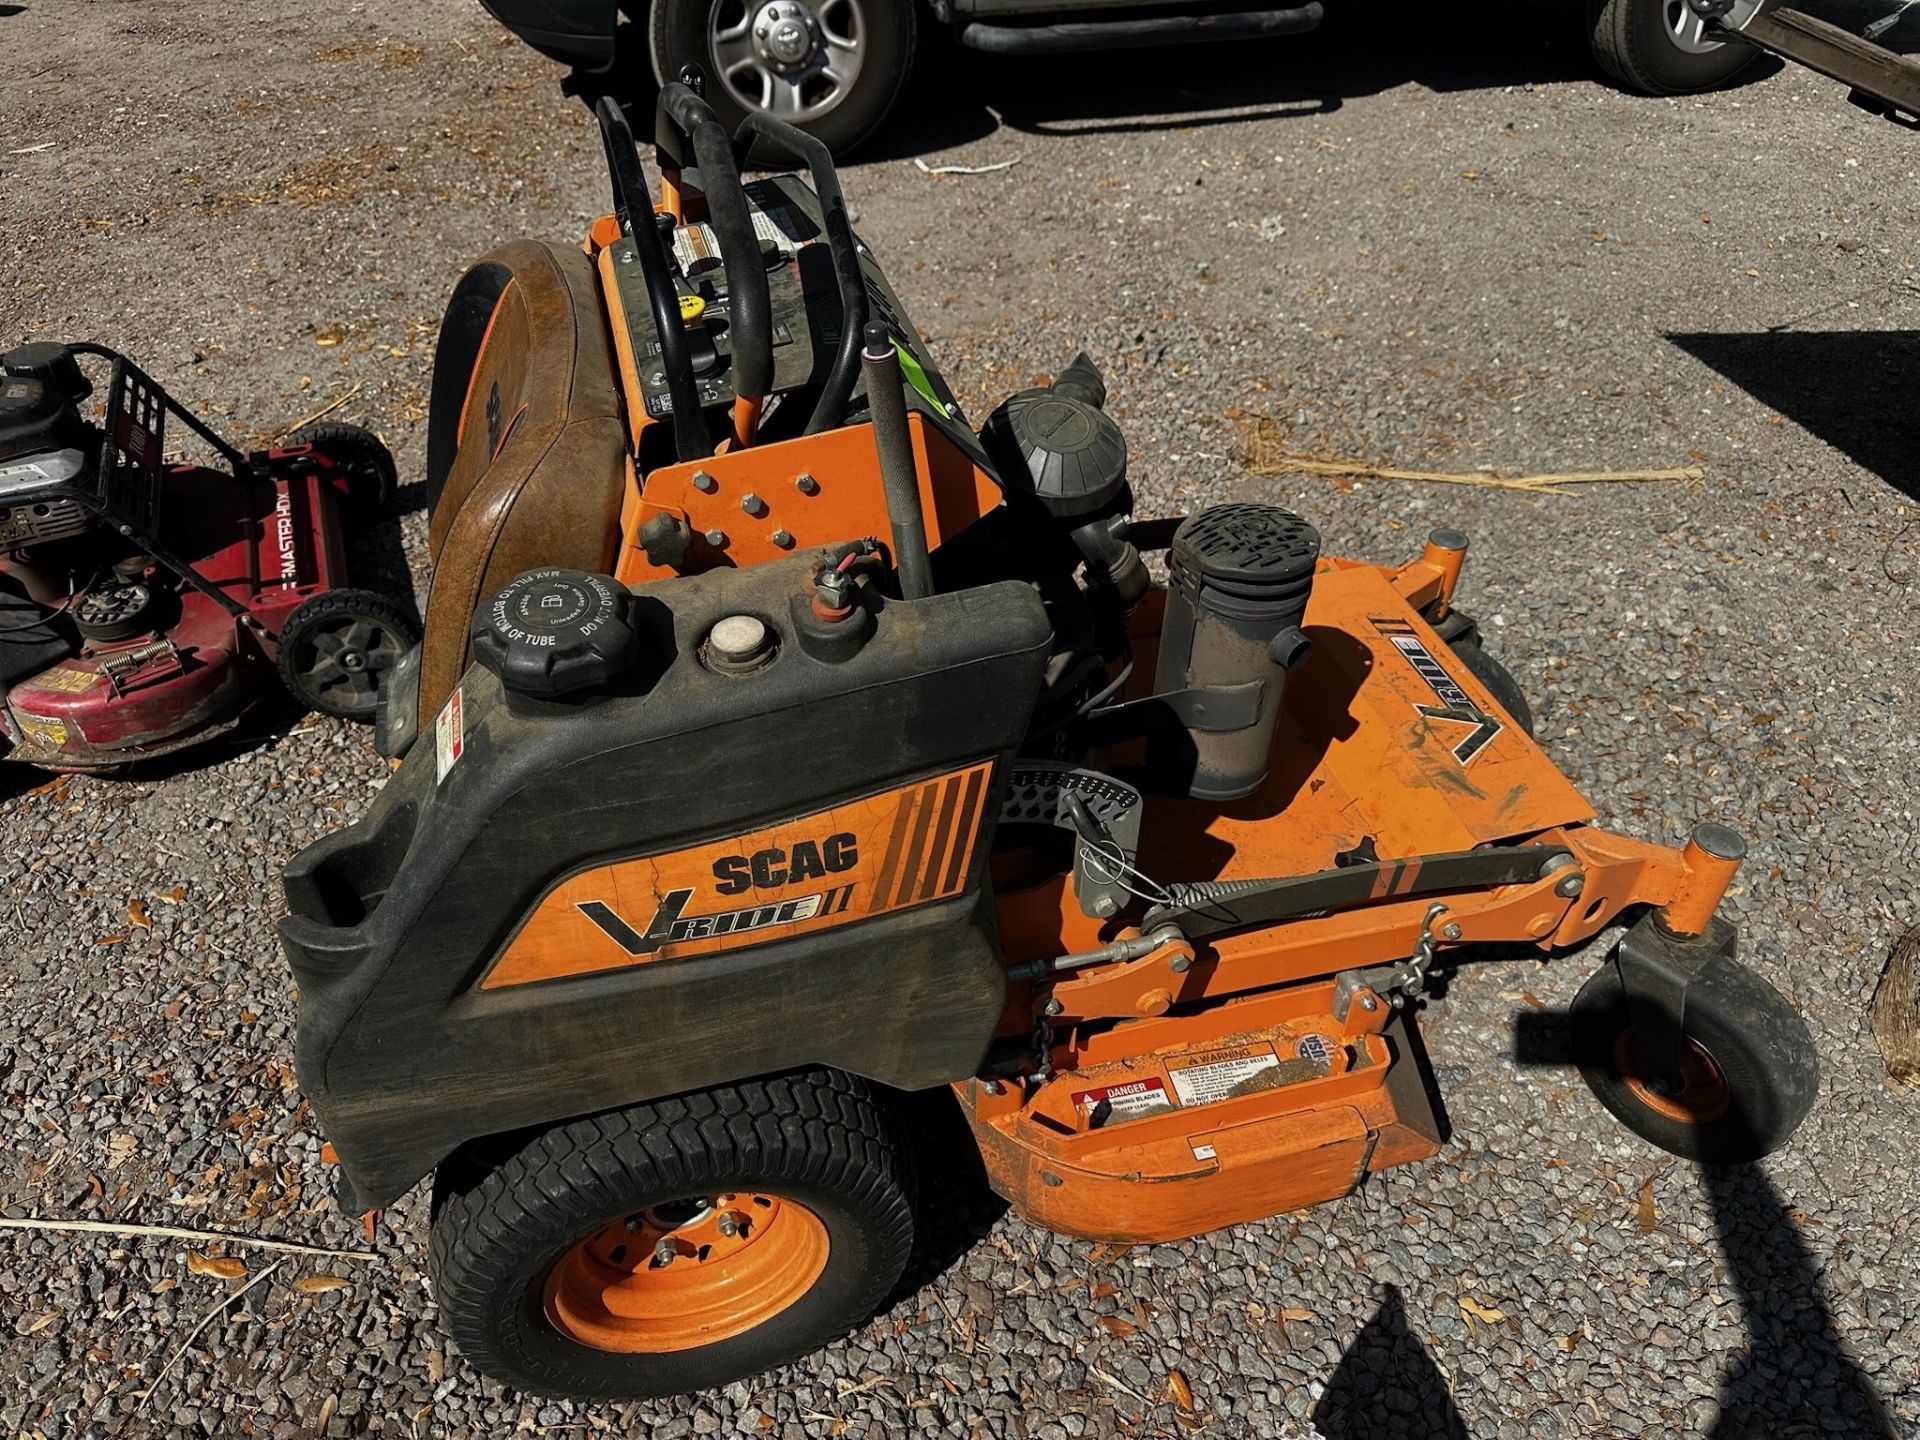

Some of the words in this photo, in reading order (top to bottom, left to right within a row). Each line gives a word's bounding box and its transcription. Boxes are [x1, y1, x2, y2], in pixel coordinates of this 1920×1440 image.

[276, 492, 291, 518] HDX
[535, 570, 560, 579] MAX
[510, 576, 534, 588] FILL
[499, 589, 515, 599] TO
[584, 576, 613, 606] OVERFILL
[492, 600, 513, 633] BOTTOM
[508, 629, 526, 641] OF
[580, 622, 598, 636] DO
[525, 634, 556, 646] TUBE
[712, 832, 859, 896] SCAG
[1305, 1035, 1327, 1058] USA
[1199, 1048, 1251, 1063] WARNING
[1178, 1066, 1209, 1076] ROTATING
[1210, 1062, 1234, 1071] BLADES
[1235, 1060, 1249, 1068] AND
[1250, 1056, 1268, 1064] BELTS
[1106, 1083, 1147, 1098] DANGER
[1135, 1092, 1166, 1102] BLADES
[1196, 1094, 1210, 1103] NOT
[1210, 1091, 1228, 1100] OPER
